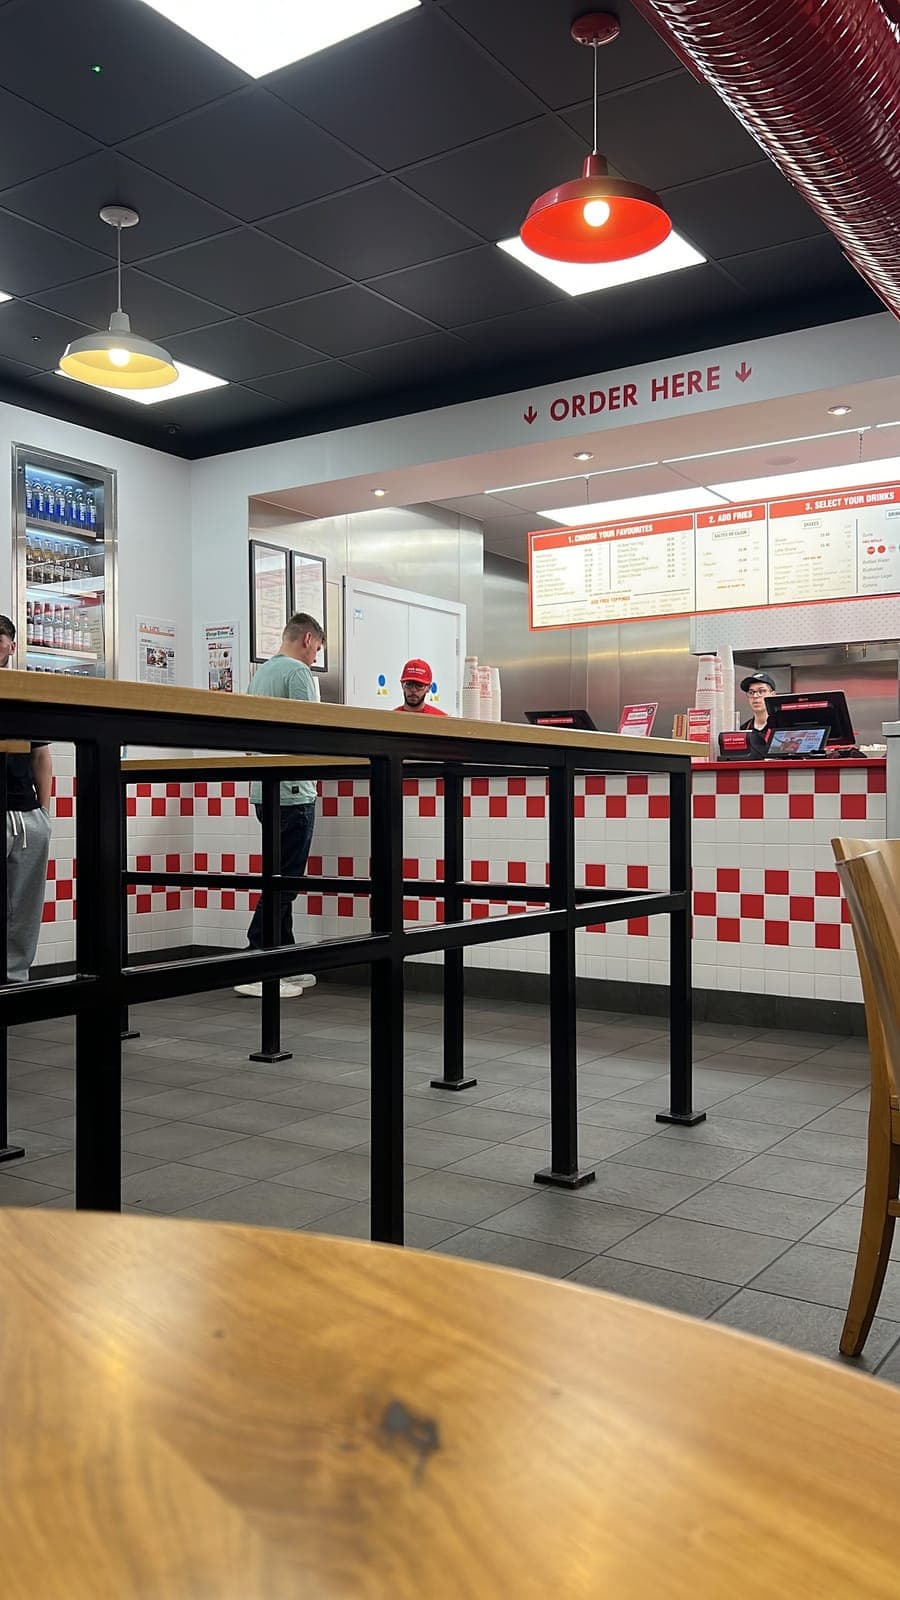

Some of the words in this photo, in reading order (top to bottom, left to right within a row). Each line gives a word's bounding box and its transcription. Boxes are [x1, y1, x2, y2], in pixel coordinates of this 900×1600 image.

[550, 384, 638, 422] ORDER
[651, 366, 720, 402] HERE
[804, 503, 813, 511] 3.
[814, 500, 842, 510] SELECT
[843, 496, 865, 506] YOUR
[866, 492, 895, 503] DRINKS
[708, 516, 716, 524] 2.
[717, 513, 732, 522] ADD
[733, 510, 752, 520] FRIES
[567, 535, 574, 544] 1.
[574, 532, 598, 542] CHOOSE
[599, 529, 615, 539] YOUR
[616, 525, 653, 536] FAVOURITES
